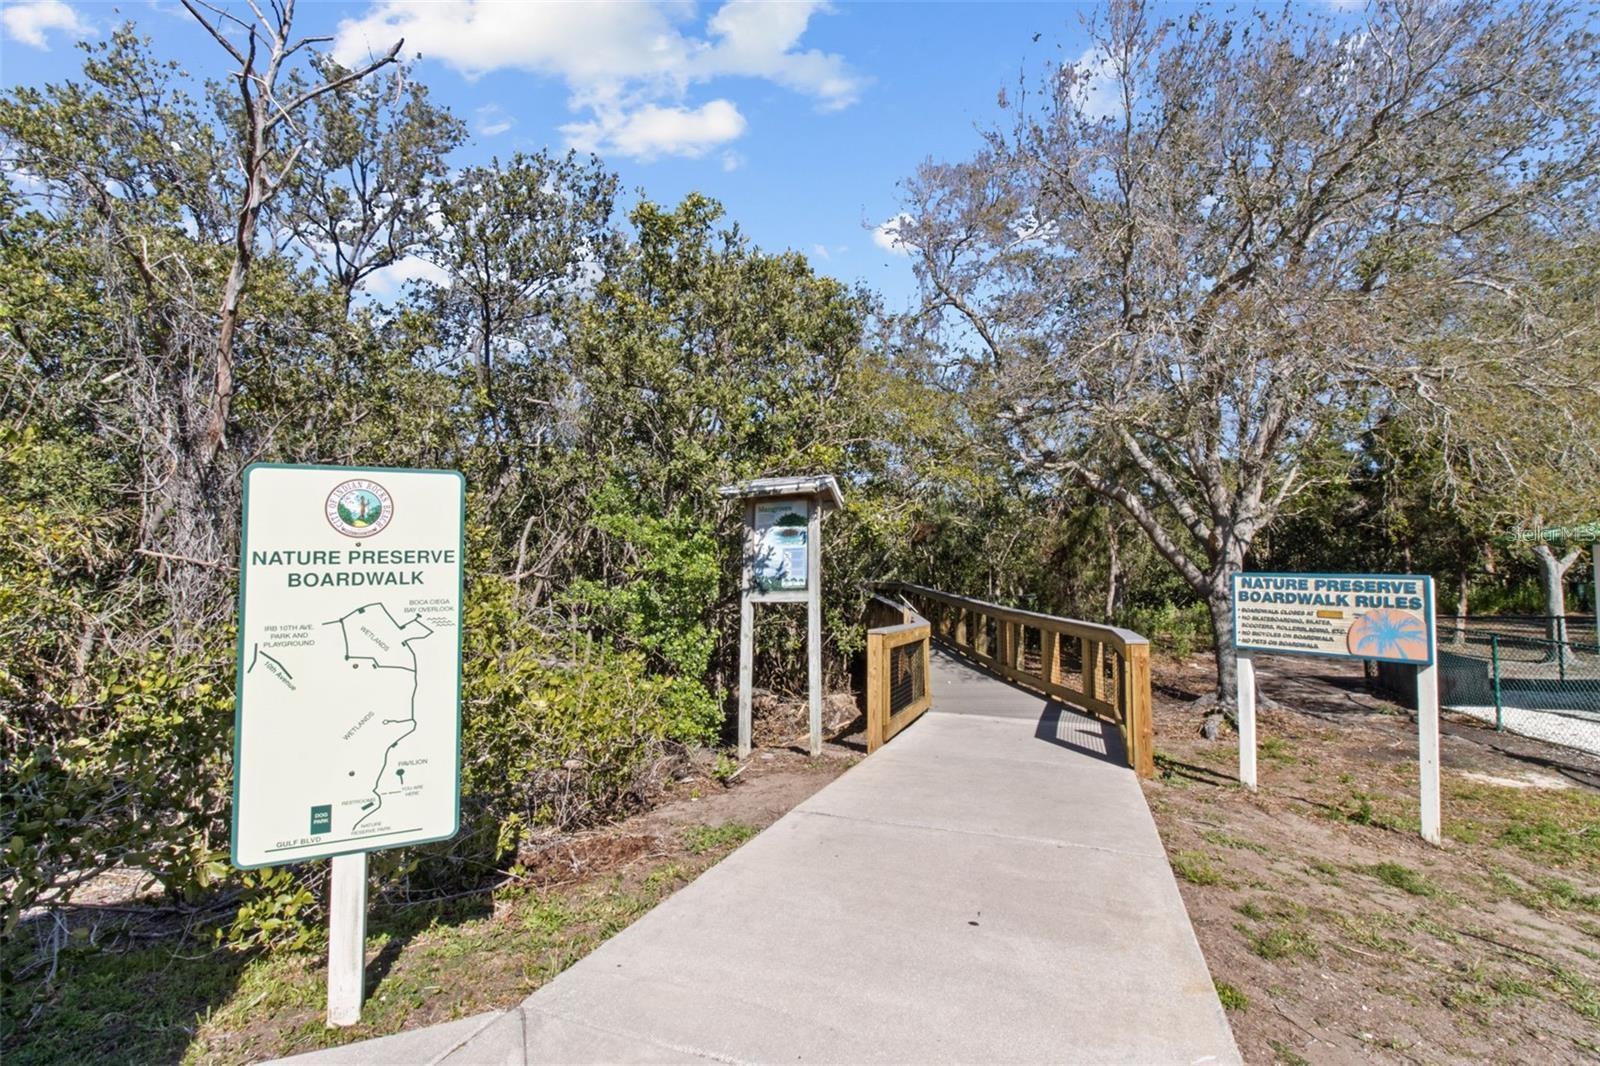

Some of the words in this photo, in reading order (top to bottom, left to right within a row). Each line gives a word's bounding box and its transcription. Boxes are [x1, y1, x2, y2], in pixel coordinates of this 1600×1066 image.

[334, 481, 363, 497] INDIAN
[366, 482, 387, 502] ROCKS
[376, 505, 392, 528] BEACH
[252, 550, 341, 565] NATURE
[349, 550, 455, 564] PRESERVE
[288, 571, 424, 587] BOARDWALK
[1241, 578, 1308, 590] NATURE
[1314, 579, 1416, 594] PRESERVE
[1238, 591, 1350, 607] BOARDWALK
[1355, 595, 1422, 610] RULES
[360, 626, 390, 652] WETLANDS
[265, 661, 276, 672] 10th
[276, 672, 296, 690] Avenue
[342, 711, 374, 740] WETLANDS
[300, 837, 321, 845] BLVD
